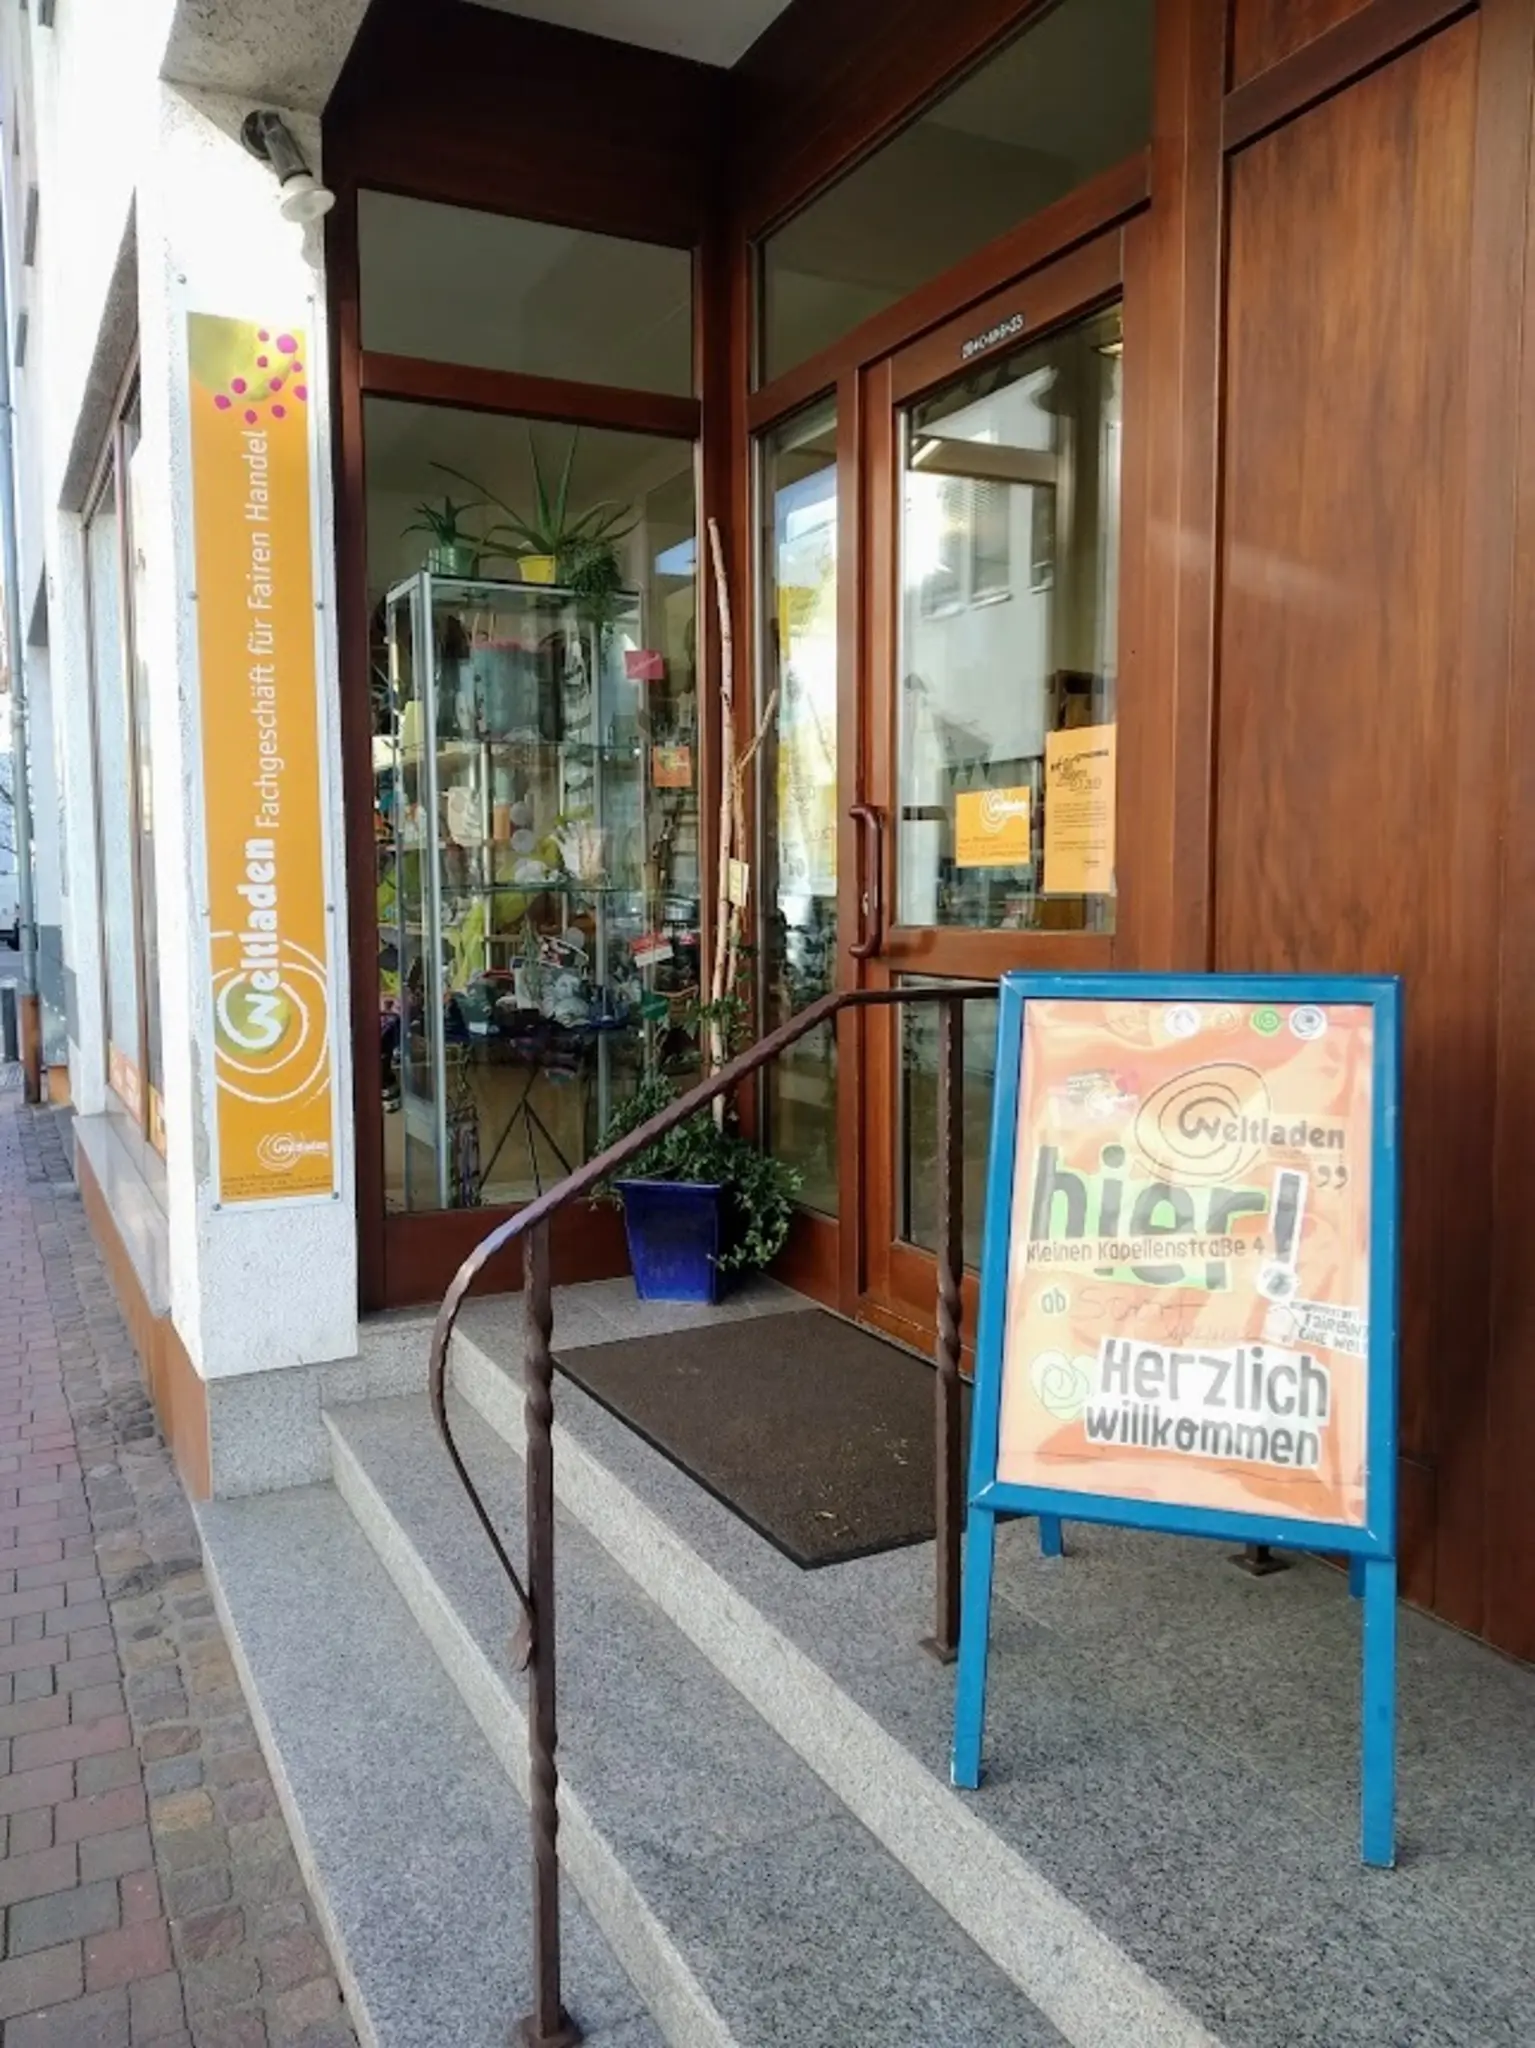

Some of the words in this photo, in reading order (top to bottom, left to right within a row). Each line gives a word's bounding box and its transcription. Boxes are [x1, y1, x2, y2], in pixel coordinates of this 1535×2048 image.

[240, 430, 270, 522] Handel
[246, 532, 275, 609] Fairen
[246, 613, 276, 657] für
[248, 664, 285, 829] Fachgeschäft
[234, 838, 282, 1048] Weltladen
[1178, 1114, 1346, 1150] Weltladen
[1027, 1239, 1092, 1264] Kleinen
[1251, 1237, 1266, 1256] 4
[1041, 1287, 1067, 1314] ab
[1100, 1339, 1328, 1418] Herzlich
[1085, 1401, 1320, 1465] willkommen
